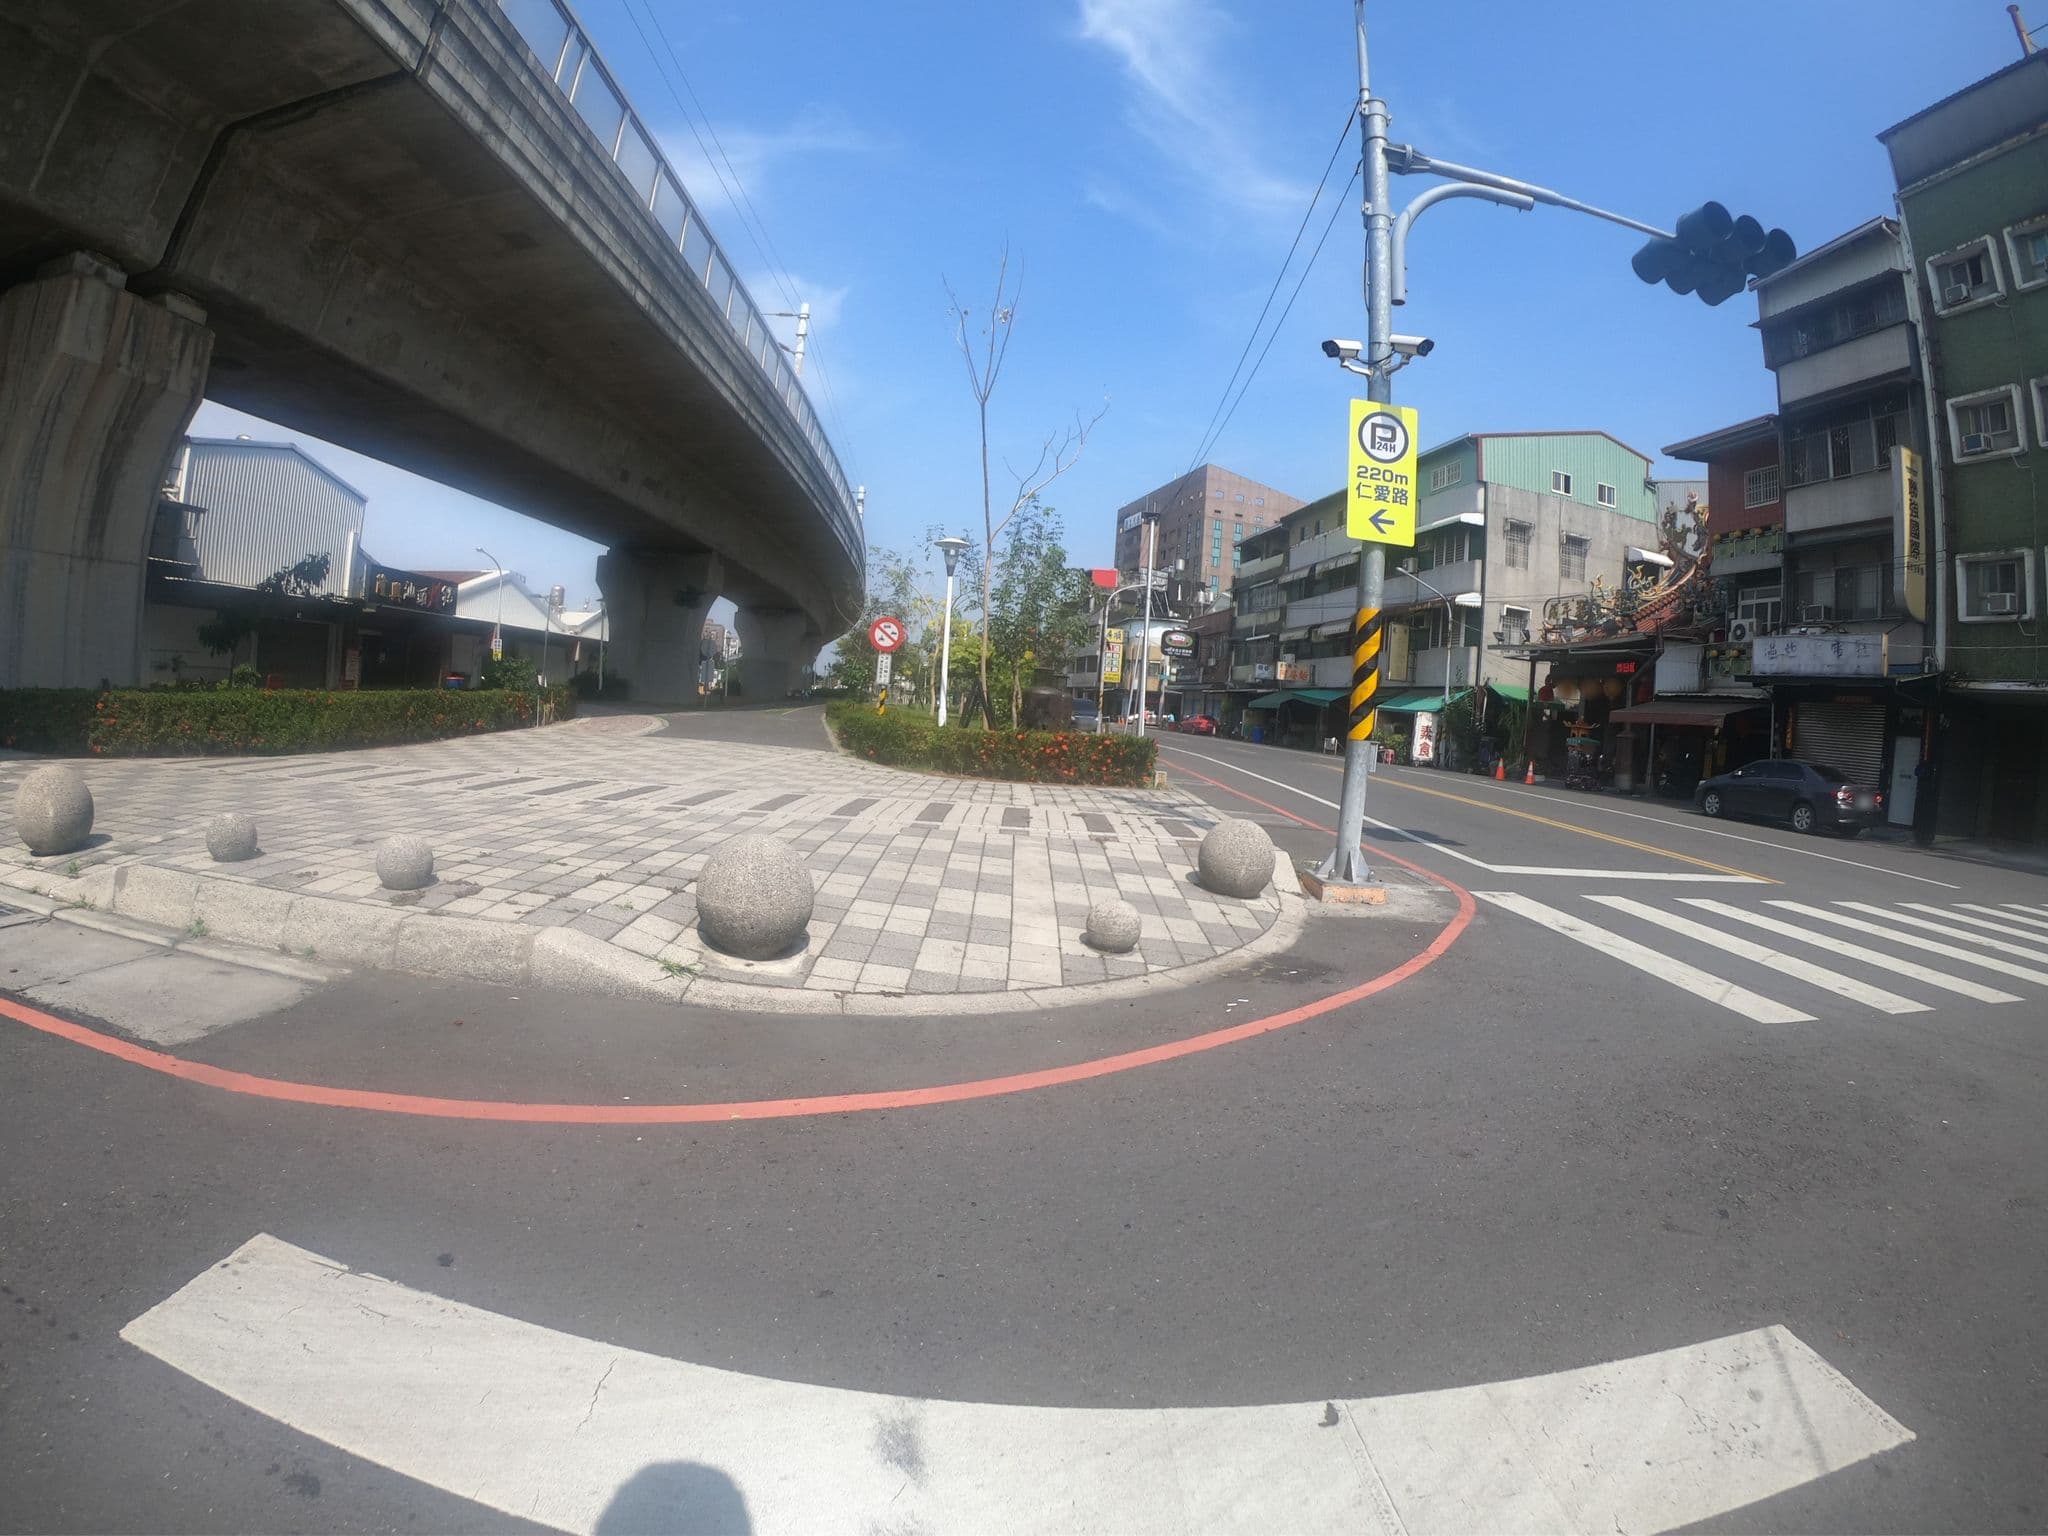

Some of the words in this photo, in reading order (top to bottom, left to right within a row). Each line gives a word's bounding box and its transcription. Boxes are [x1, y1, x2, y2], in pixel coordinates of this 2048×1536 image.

[1371, 422, 1397, 450] P
[1376, 441, 1396, 453] 24H
[1356, 465, 1409, 486] 220m
[1355, 482, 1409, 506] 仁愛路
[1418, 725, 1432, 758] 素食
